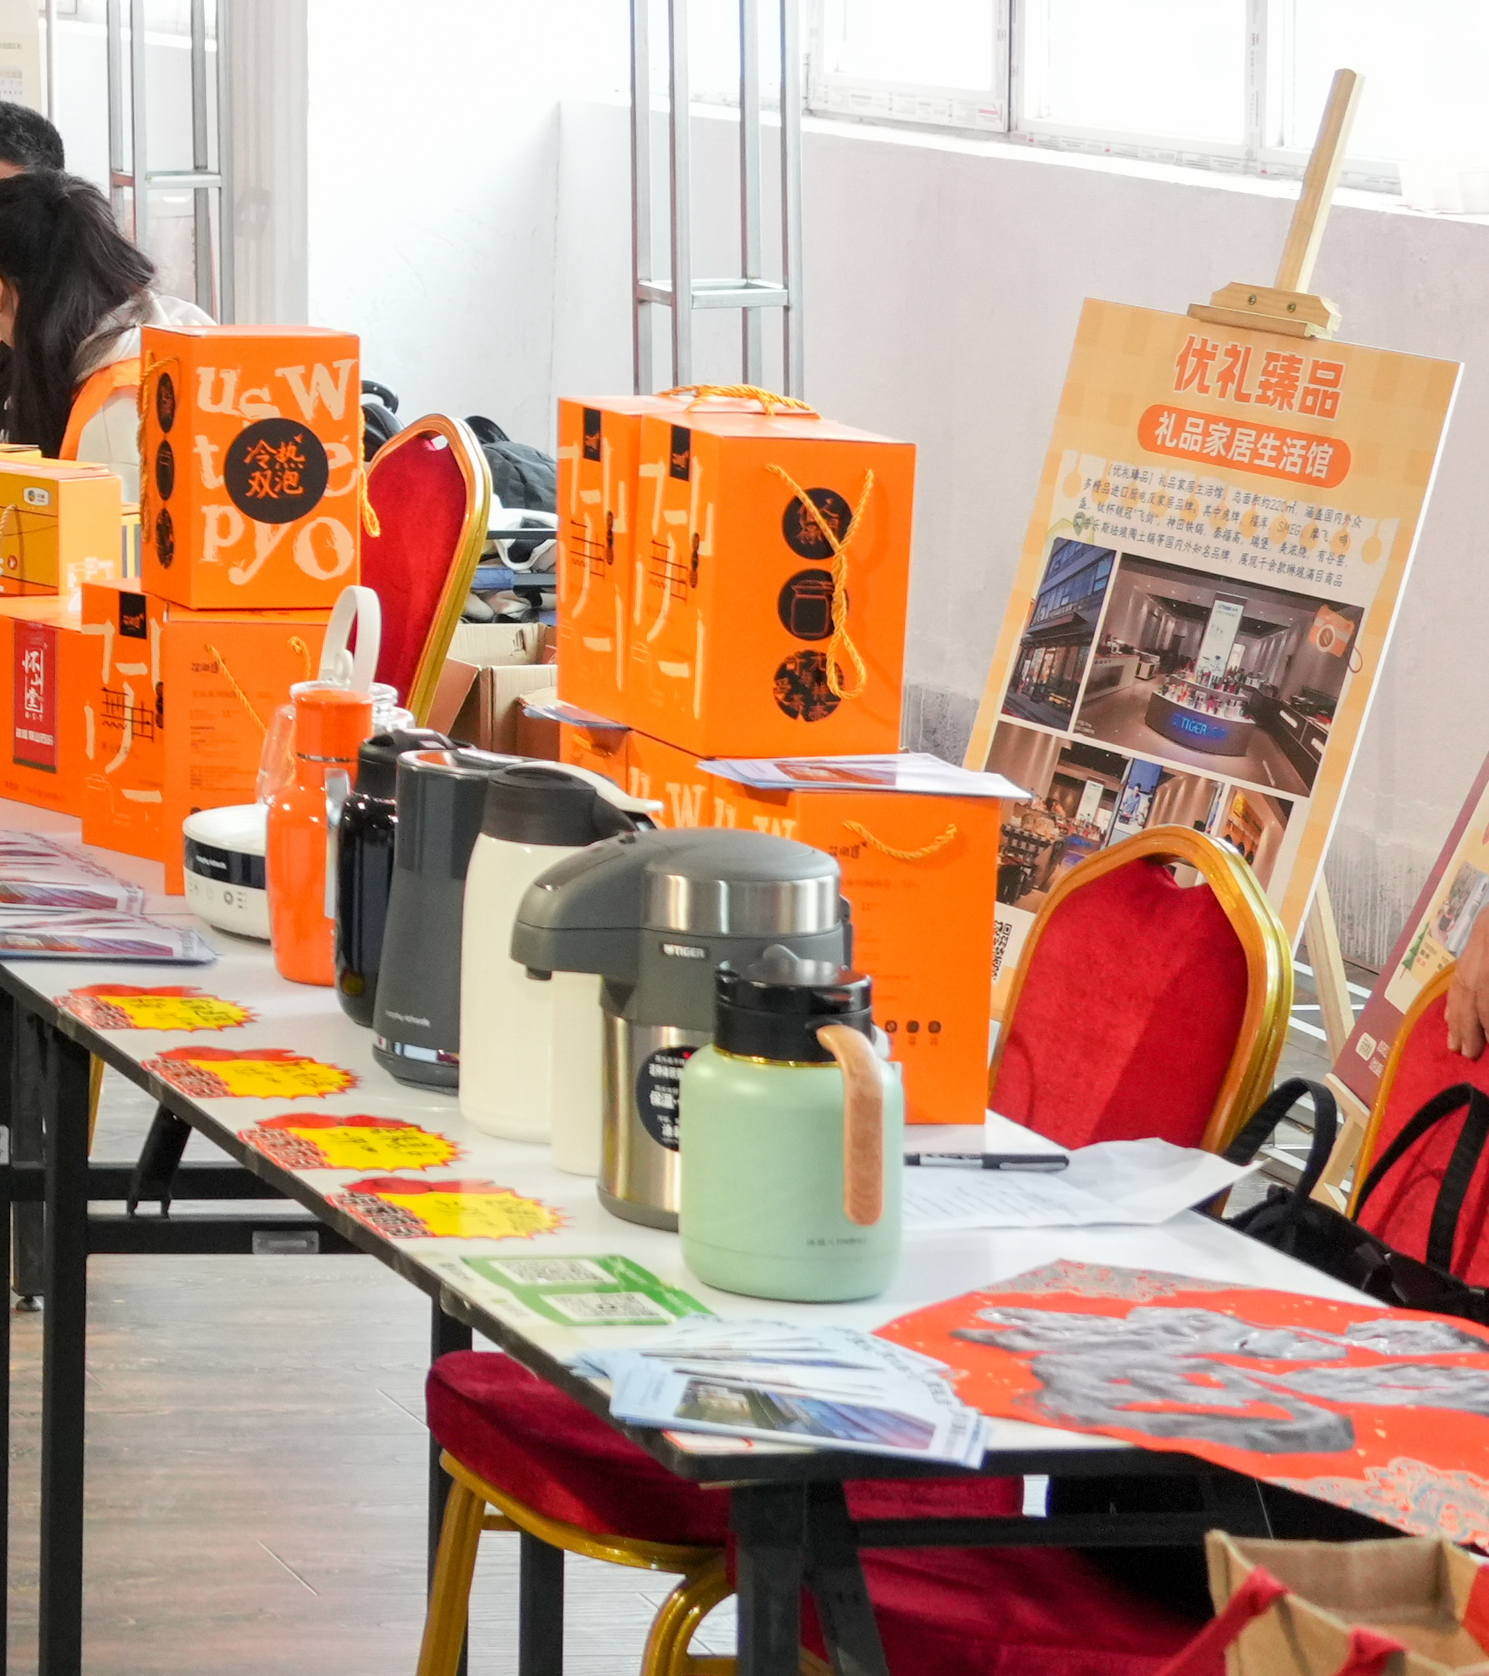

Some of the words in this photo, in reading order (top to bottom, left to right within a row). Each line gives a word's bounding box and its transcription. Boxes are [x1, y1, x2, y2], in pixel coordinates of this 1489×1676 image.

[1174, 334, 1345, 420] 优礼臻品
[1154, 411, 1334, 480] 礼品家居生活馆
[674, 945, 706, 959] TIGER
